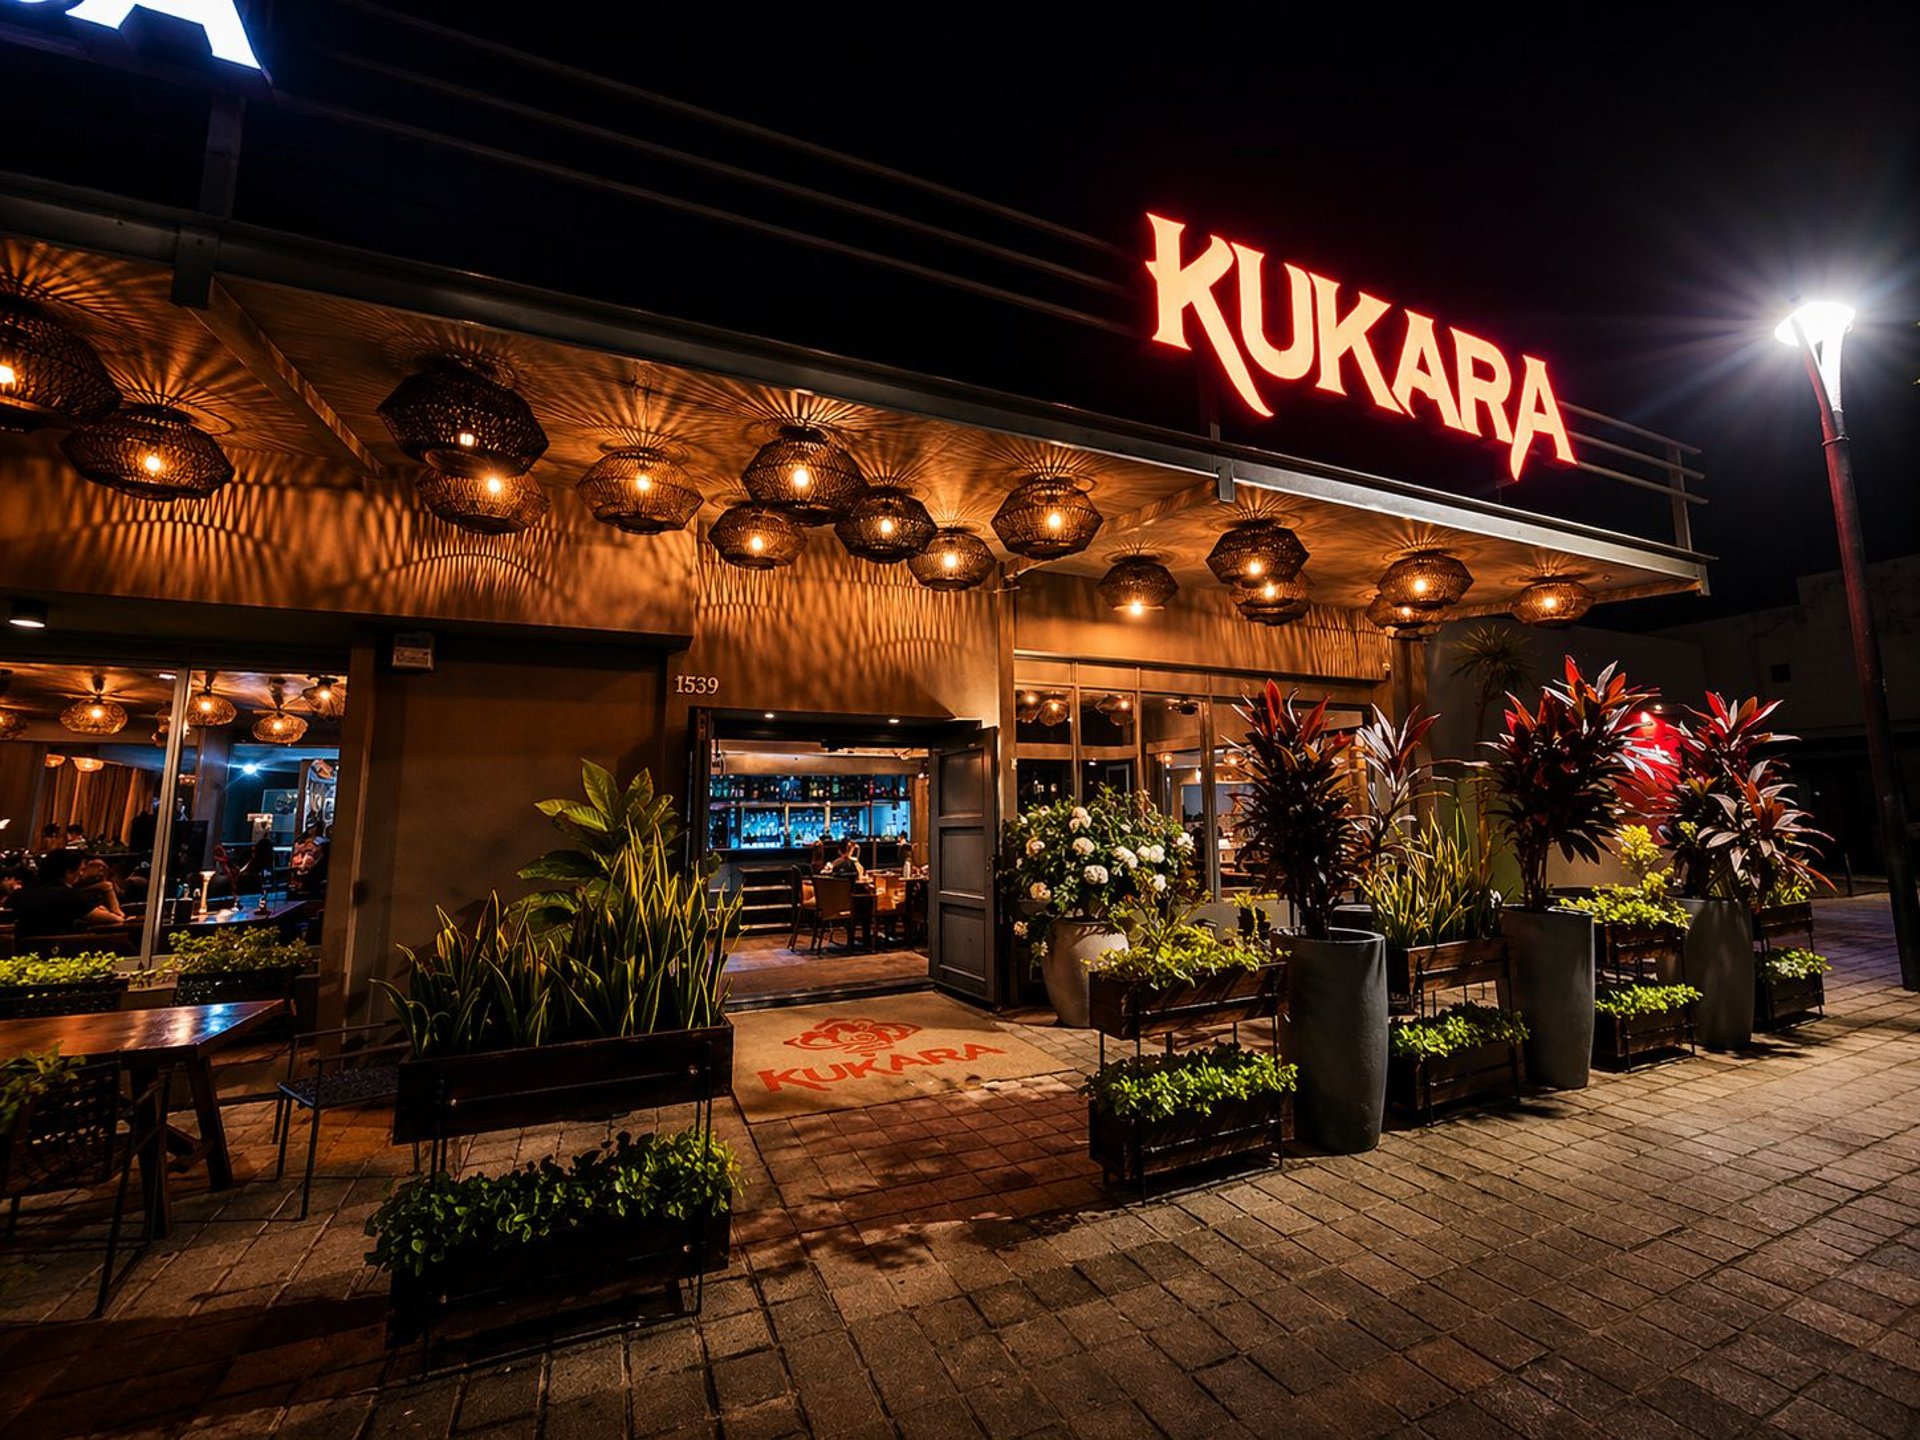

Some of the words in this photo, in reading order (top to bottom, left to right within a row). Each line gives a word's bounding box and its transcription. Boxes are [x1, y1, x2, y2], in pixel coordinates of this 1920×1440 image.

[1145, 211, 1578, 482] KUKARA
[675, 675, 719, 694] 1539
[757, 1043, 1006, 1093] KUKARA
